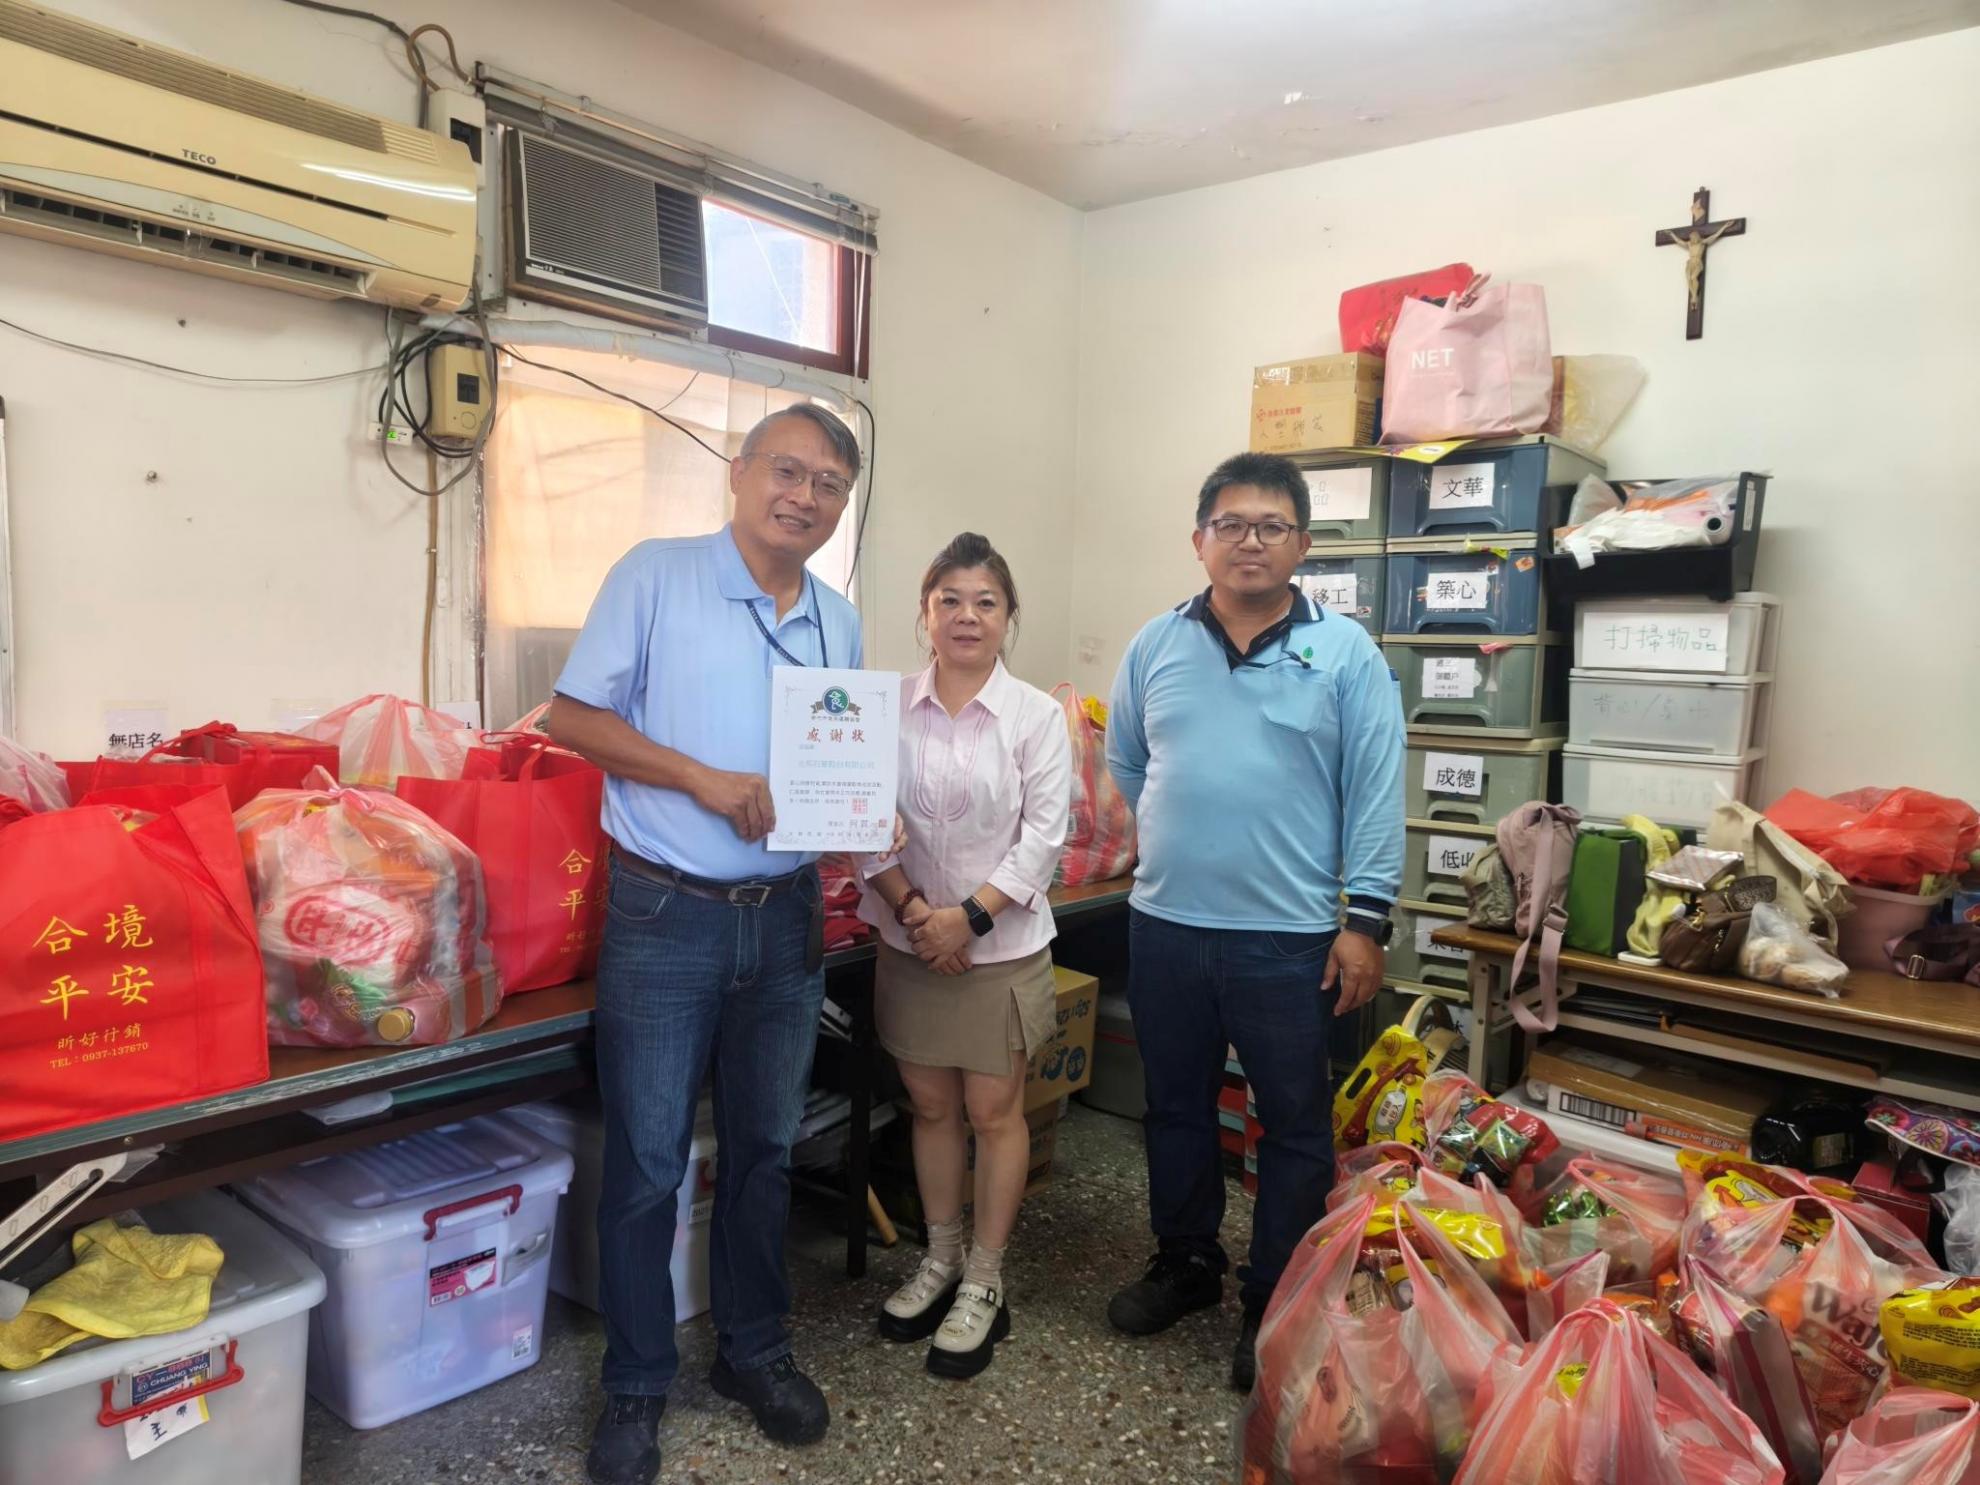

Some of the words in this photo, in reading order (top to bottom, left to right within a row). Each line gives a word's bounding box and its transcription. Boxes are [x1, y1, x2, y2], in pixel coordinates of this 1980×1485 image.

[182, 148, 217, 165] TECO
[1411, 347, 1455, 369] NET
[1442, 477, 1484, 499] 文華
[1436, 580, 1477, 600] 築心
[1604, 624, 1717, 652] 打掃物品
[109, 732, 163, 749] 無店名
[1436, 767, 1476, 788] 成德
[32, 904, 154, 955] 合境
[39, 964, 155, 1021] 平安
[189, 1361, 209, 1373] YING
